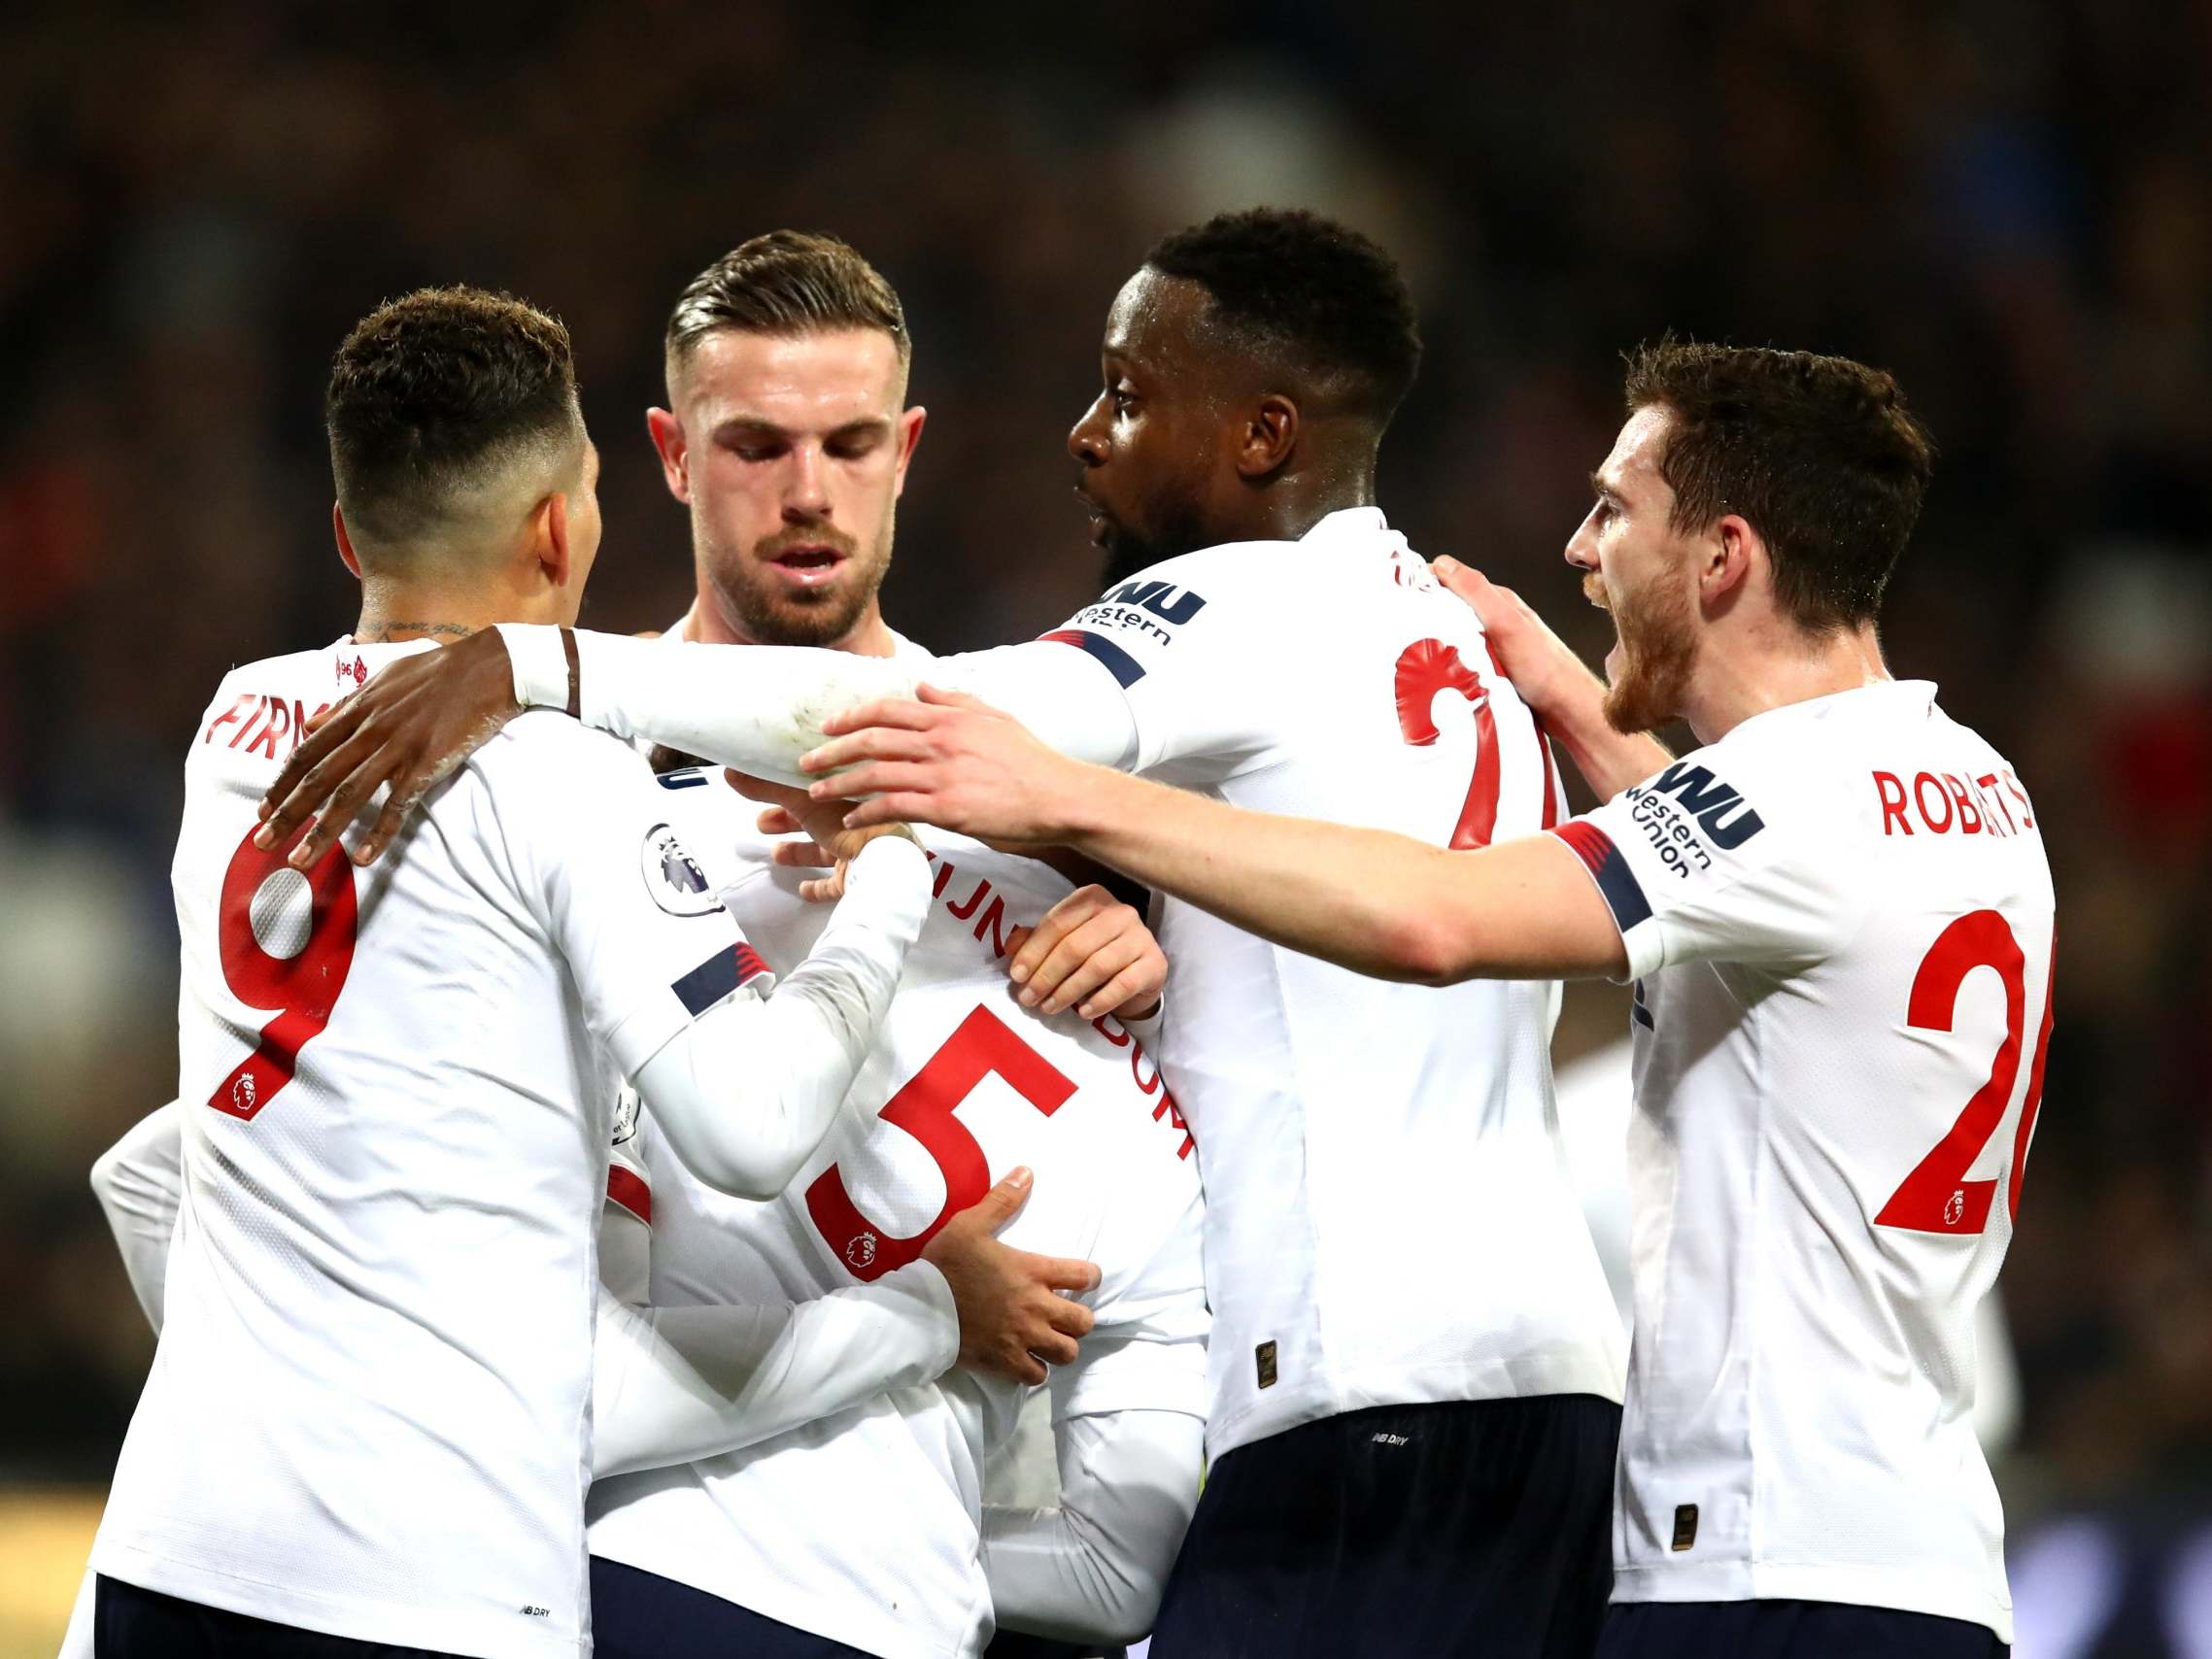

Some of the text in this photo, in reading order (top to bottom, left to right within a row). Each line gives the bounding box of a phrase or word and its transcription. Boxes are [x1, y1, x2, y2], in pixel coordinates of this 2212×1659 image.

[1632, 805, 1689, 879] Union
[1652, 762, 1765, 851] WU
[207, 814, 357, 1122] 9
[804, 1003, 1079, 1283] 5
[1387, 1434, 1408, 1446] DRY
